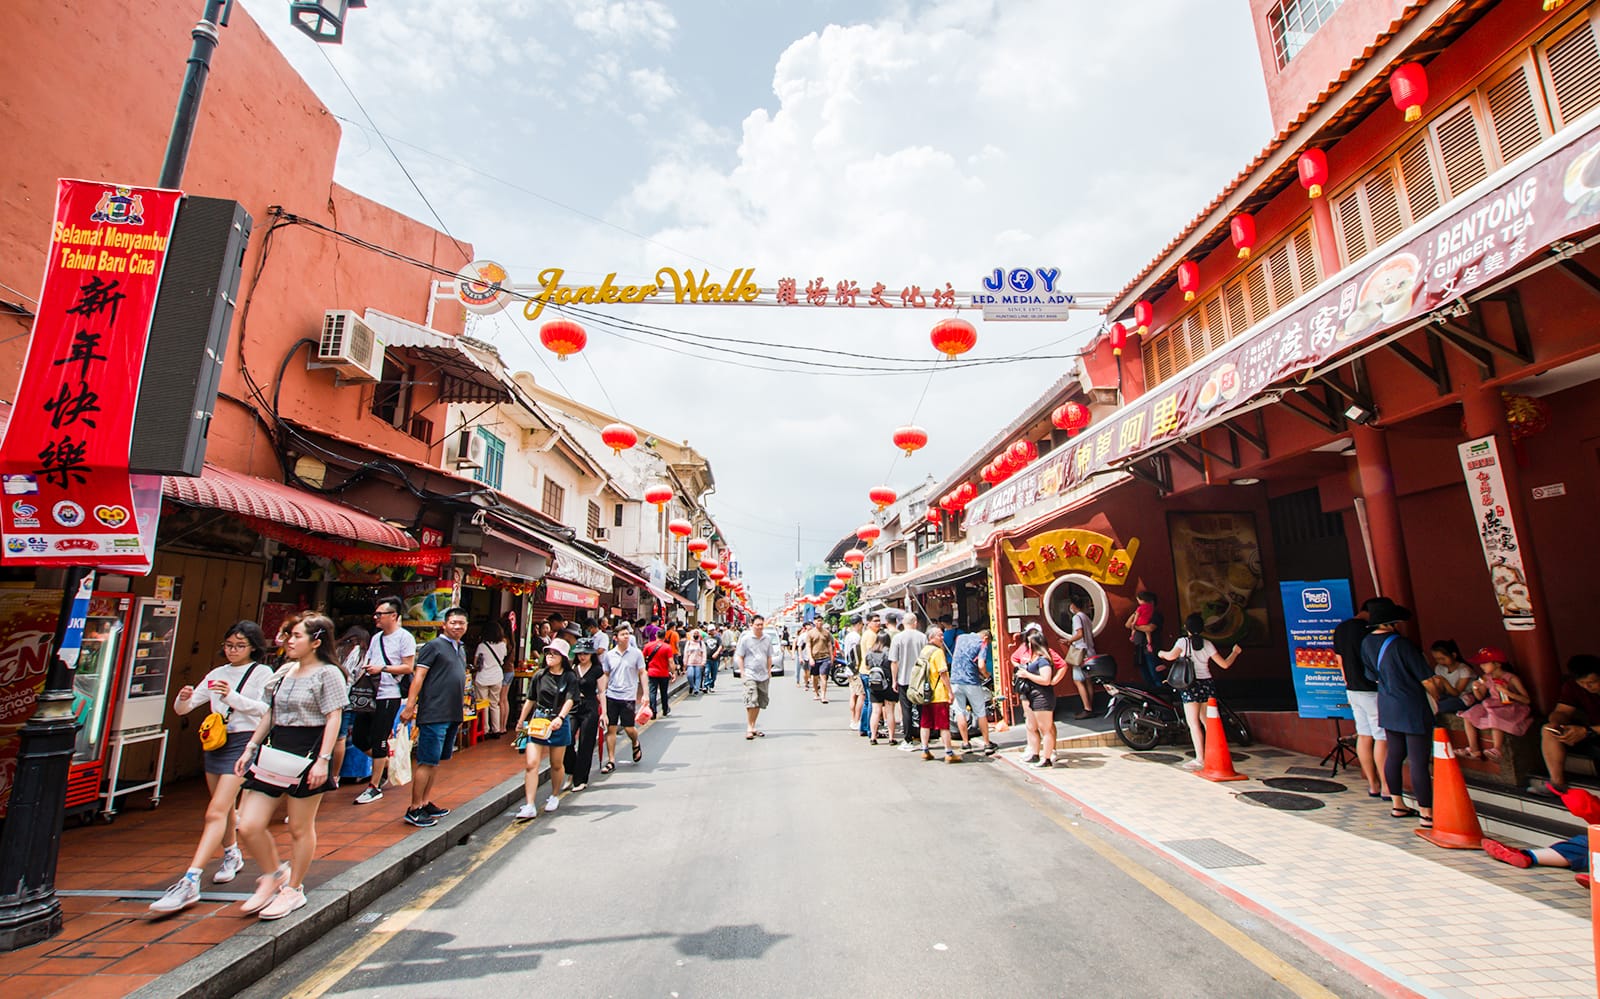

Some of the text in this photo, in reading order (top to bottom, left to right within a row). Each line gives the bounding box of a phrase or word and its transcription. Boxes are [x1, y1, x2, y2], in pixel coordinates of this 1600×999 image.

[1435, 177, 1538, 260] BENTONG
[54, 222, 103, 249] Selamat
[1433, 212, 1535, 279] GINGER TEA
[61, 247, 156, 276] Tahun Baru Cina
[523, 267, 761, 321] Jonker Walk
[984, 268, 1060, 293] JOY
[973, 295, 1076, 304] LED. MEDIA. ADV.
[1249, 345, 1274, 364] NEST
[32, 275, 126, 489] 新年快樂
[1304, 674, 1331, 682] Jonker
